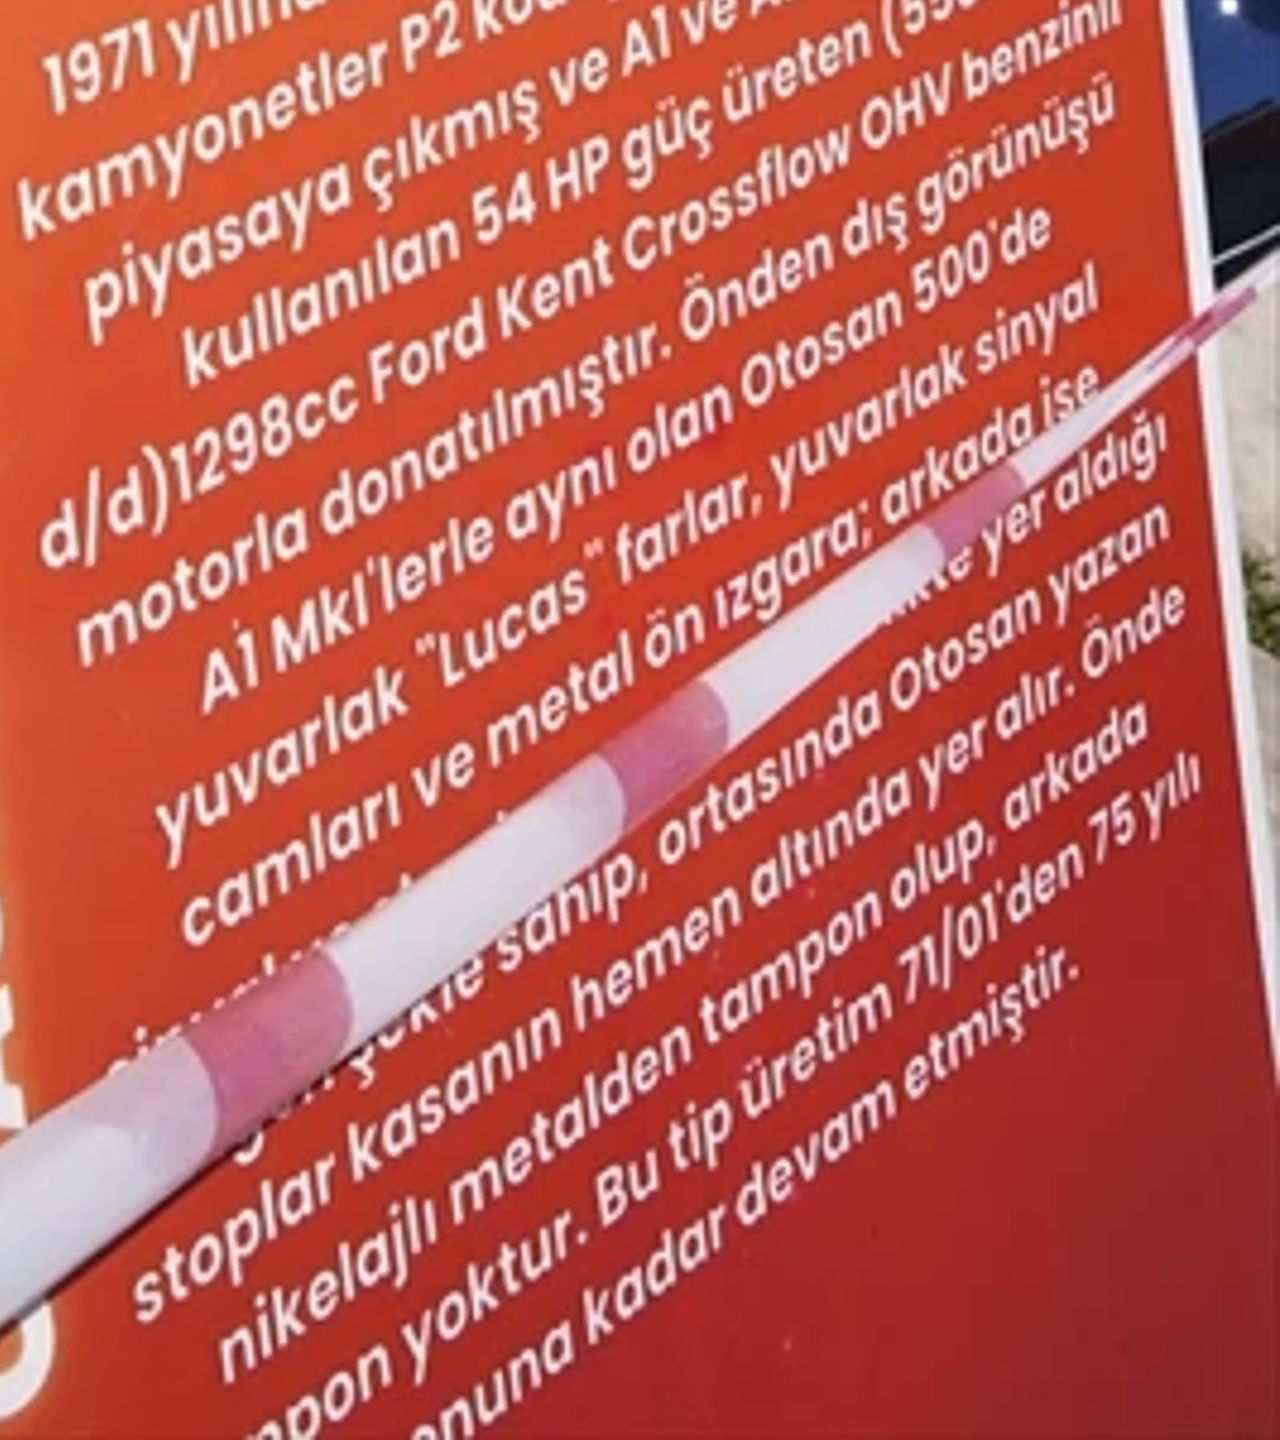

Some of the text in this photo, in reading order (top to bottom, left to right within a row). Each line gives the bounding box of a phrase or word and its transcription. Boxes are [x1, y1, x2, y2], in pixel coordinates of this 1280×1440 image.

[17, 40, 388, 240] kamyonetler
[40, 375, 358, 568] d/d)1298cc
[368, 295, 486, 404] Ford
[495, 236, 614, 338] Kent
[622, 123, 850, 271] Crossflow
[860, 61, 951, 149] OHV
[42, 17, 155, 114] 1971
[84, 162, 351, 346] piyasaya
[362, 79, 540, 212] çıkmış
[548, 46, 609, 105] ve
[621, 4, 671, 76] A1
[182, 218, 460, 387] kullanılan
[471, 170, 537, 243] 54
[545, 134, 610, 211] HP
[621, 95, 712, 191] güç
[721, 19, 872, 122] üreten
[77, 72, 1114, 667] motorla donatılmıştır. Önden dış görünüşü
[155, 261, 1098, 869] yuvarlak "Lucas" farlar, yuvarlak sinyal
[202, 619, 259, 714] A1
[505, 447, 616, 542] aynı
[626, 384, 733, 472] olan
[740, 290, 902, 406] Otosan
[911, 208, 1051, 312] 500'de
[981, 411, 1165, 576] yer aldığı
[181, 782, 401, 946] camları
[410, 741, 475, 807] ve
[486, 629, 634, 766] metal
[644, 603, 704, 668] ön
[881, 404, 1032, 523] arkada
[658, 689, 881, 864] ortasında
[889, 588, 1041, 711] Otosan
[1047, 504, 1169, 625] yazan
[133, 1153, 335, 1322] stoplar
[346, 1007, 562, 1181] kasanın
[570, 886, 741, 1030] hemen
[750, 768, 911, 907] altında
[917, 717, 986, 810] yer
[995, 666, 1075, 739] alır.
[1081, 585, 1185, 678] Önde
[219, 1196, 437, 1383] nikelajlı
[448, 1025, 691, 1224] metalden
[699, 890, 882, 1043] tampon
[889, 818, 994, 910] olup,
[1003, 702, 1147, 830] arkada
[401, 1210, 586, 1385] yoktur.
[595, 1149, 659, 1226] Bu
[667, 1098, 732, 1170] tip
[738, 982, 892, 1118] üretim
[898, 842, 1084, 1002] 71/01'den
[1088, 791, 1136, 862] 75
[1140, 751, 1200, 840] yılı
[411, 945, 1078, 1440] nuna kadar devam etmiştir.
